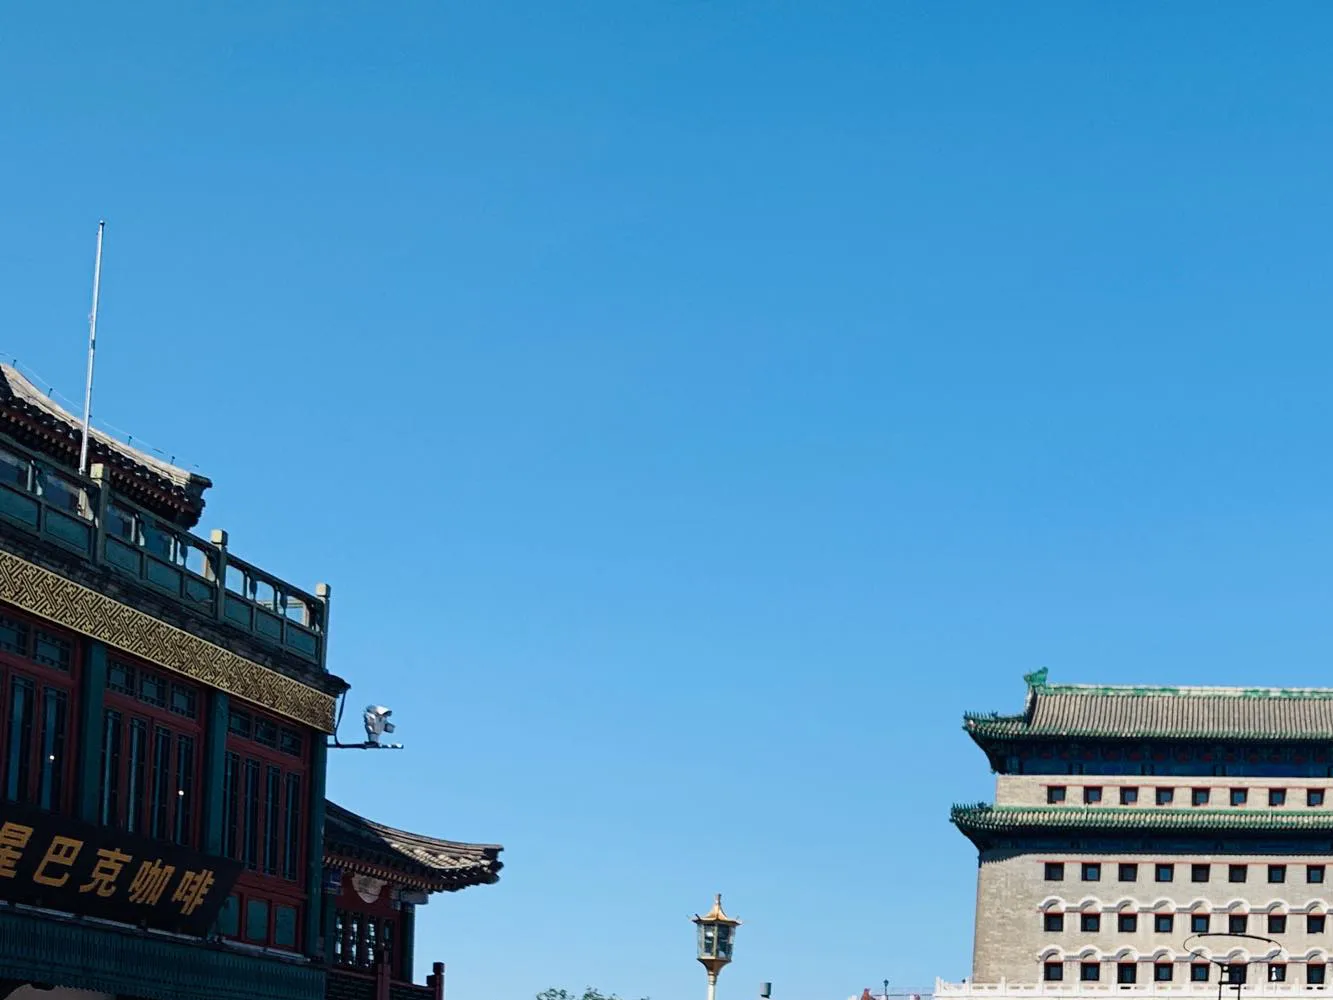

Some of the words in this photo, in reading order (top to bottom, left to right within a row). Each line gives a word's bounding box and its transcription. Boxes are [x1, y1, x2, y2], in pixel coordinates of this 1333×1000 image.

[0, 821, 215, 916] 星巴克咖啡
